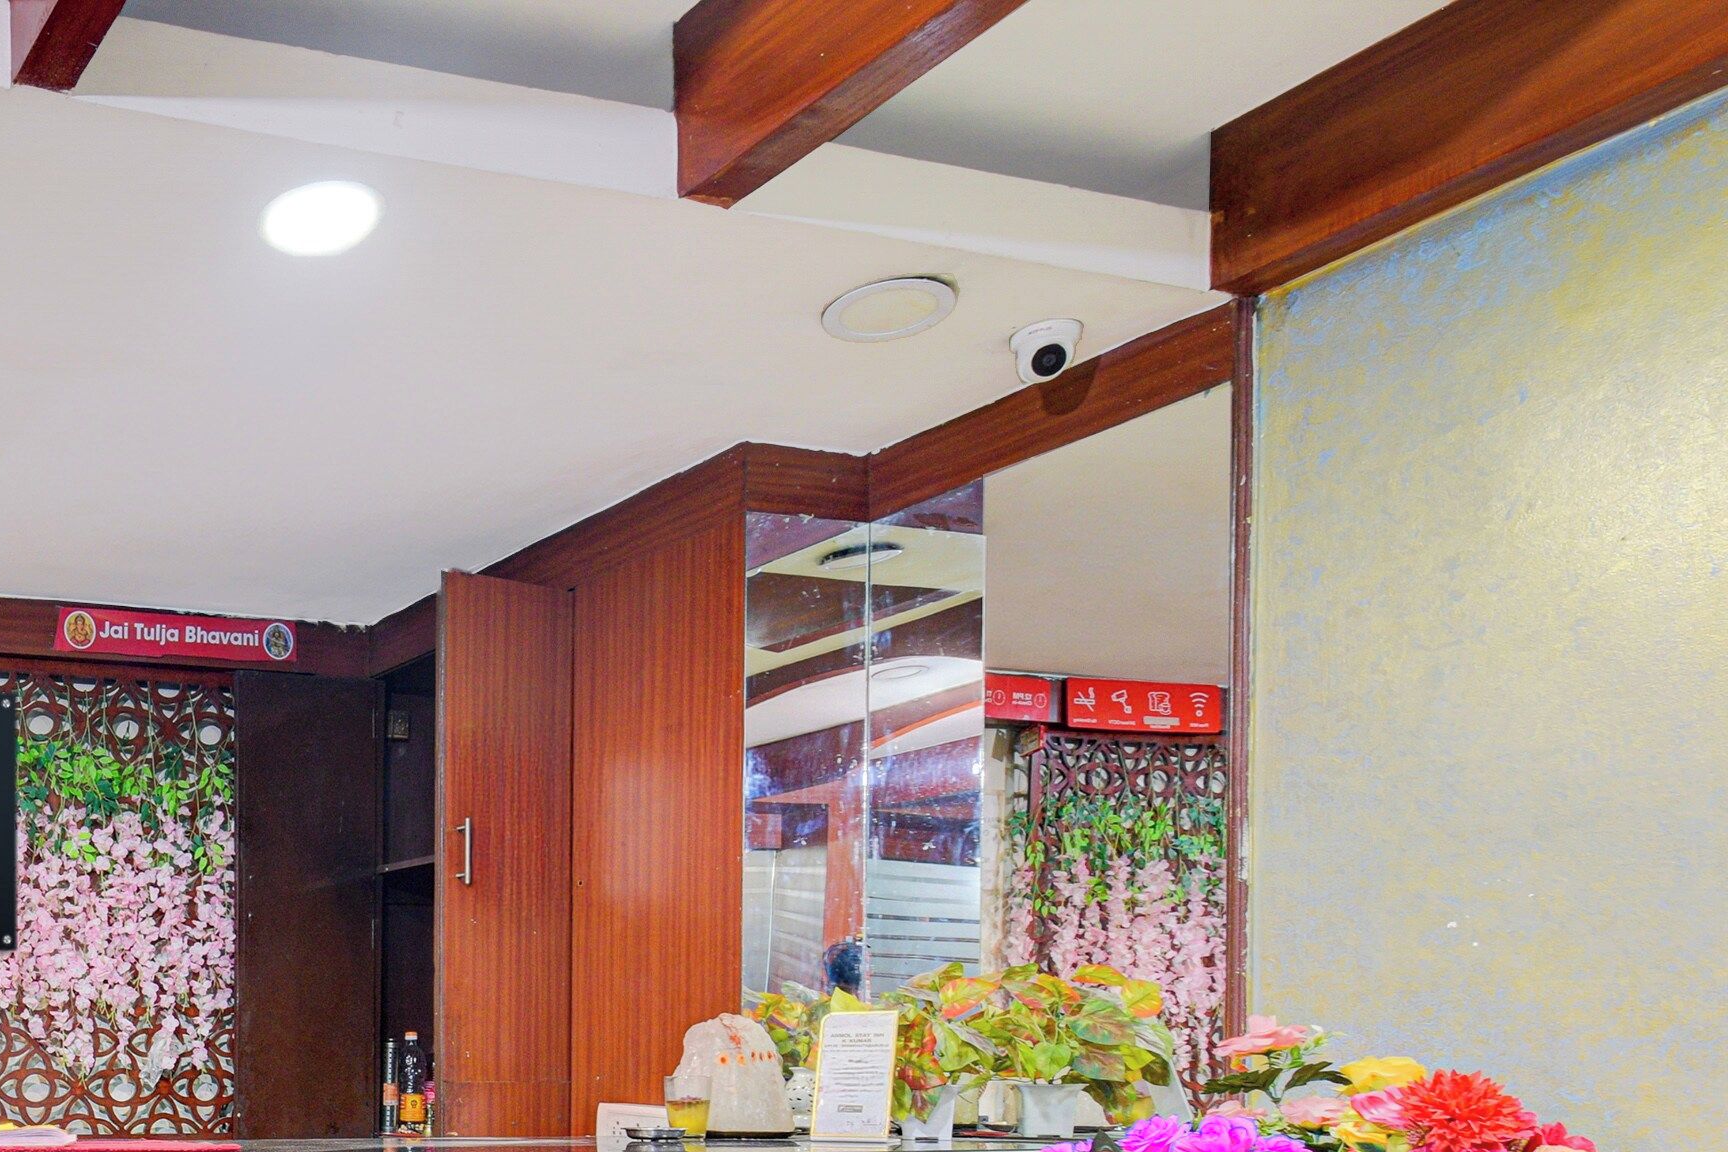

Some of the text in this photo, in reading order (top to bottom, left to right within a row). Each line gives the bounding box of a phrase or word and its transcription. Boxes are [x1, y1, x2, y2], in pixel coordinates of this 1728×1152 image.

[99, 621, 259, 647] Jai Tulja Bhavani
